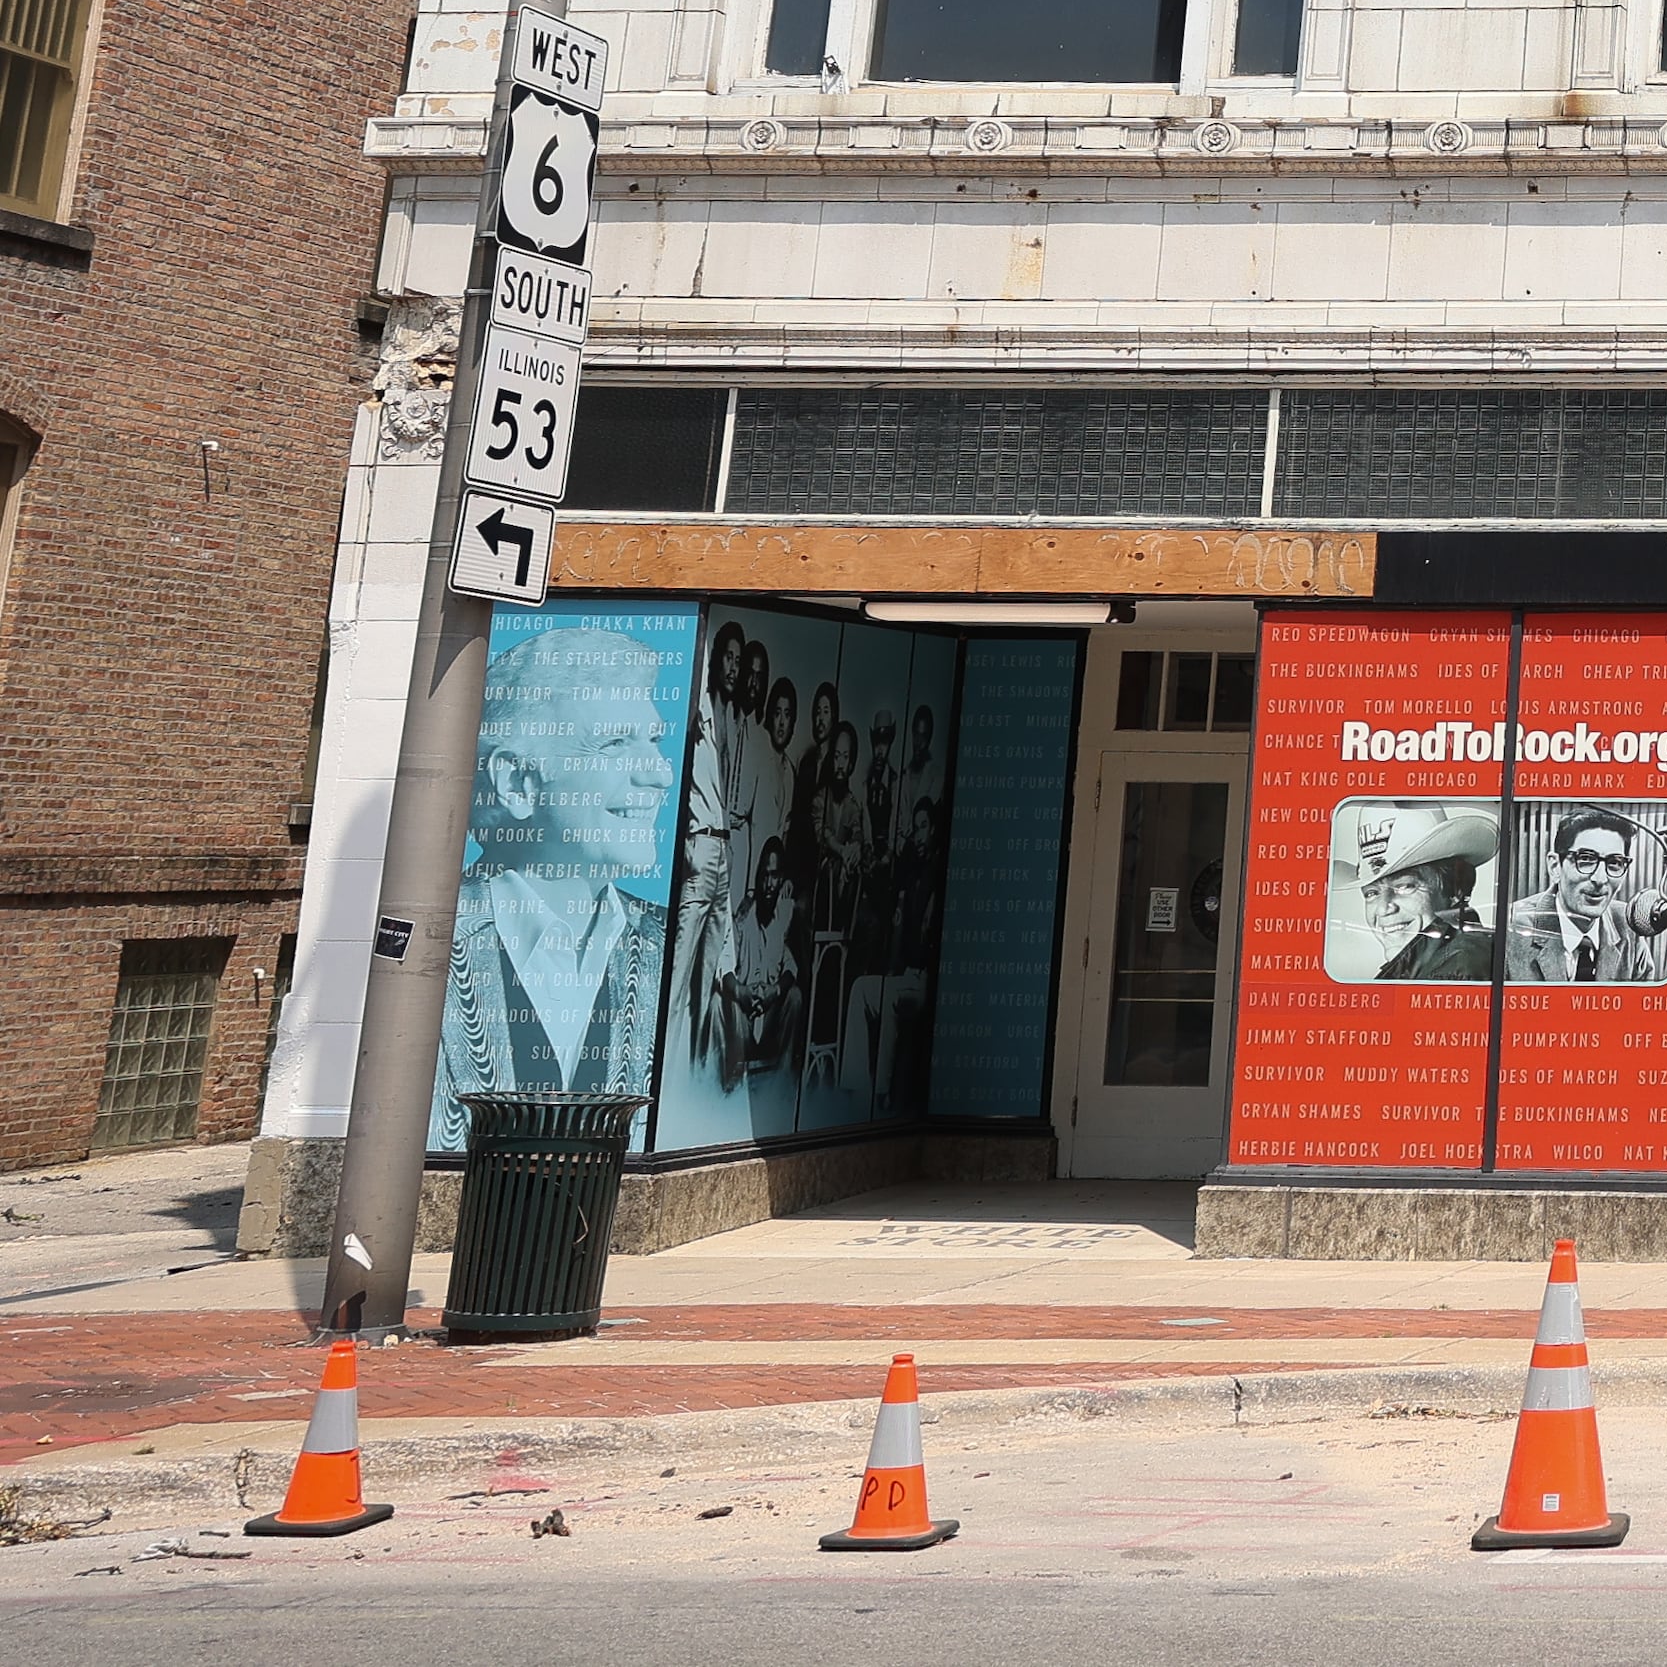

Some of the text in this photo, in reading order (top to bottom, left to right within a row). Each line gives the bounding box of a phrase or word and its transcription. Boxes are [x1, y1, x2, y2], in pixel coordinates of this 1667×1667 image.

[530, 30, 597, 90] WEST
[532, 135, 564, 215] 6
[500, 270, 586, 328] SOUTH
[497, 348, 565, 386] ILLINOIS
[485, 387, 558, 470] 53
[581, 616, 685, 630] CHAKA KHAN
[1272, 627, 1300, 641] REO
[1309, 628, 1410, 642] SPEEDWAGON
[1430, 628, 1477, 642] CRYAN
[1487, 628, 1552, 642] SHMES
[1573, 629, 1639, 643] CHICAGO
[1270, 663, 1298, 677] THE
[1306, 664, 1418, 678] BUCKINGHAMS
[1439, 664, 1472, 678] IDES
[1482, 664, 1498, 678] OF
[1523, 664, 1563, 678] ARCH
[1584, 664, 1633, 679] CHEAP
[572, 687, 682, 701] TOM MORELLO
[1263, 772, 1292, 786] NAT
[1301, 772, 1338, 786] KING
[1347, 772, 1386, 786] COLE
[1407, 772, 1476, 787] CHICAGO
[1581, 774, 1624, 788] MARX
[563, 827, 666, 843] CHUCK BERRY
[1249, 992, 1279, 1006] DAN
[1288, 993, 1380, 1008] FOGELBERG
[1411, 992, 1490, 1009] MATERIAL
[1502, 994, 1549, 1010] ISSUE
[1571, 995, 1621, 1010] WILCO
[1242, 1103, 1290, 1118] CRYAN
[1299, 1104, 1361, 1119] SHAMES
[1382, 1105, 1460, 1121] SURVIVOR
[1476, 1106, 1507, 1122] TE
[1515, 1107, 1628, 1122] BUCKINGHAMS
[878, 1225, 1139, 1238] WHITE
[837, 1236, 1103, 1249] STORE
